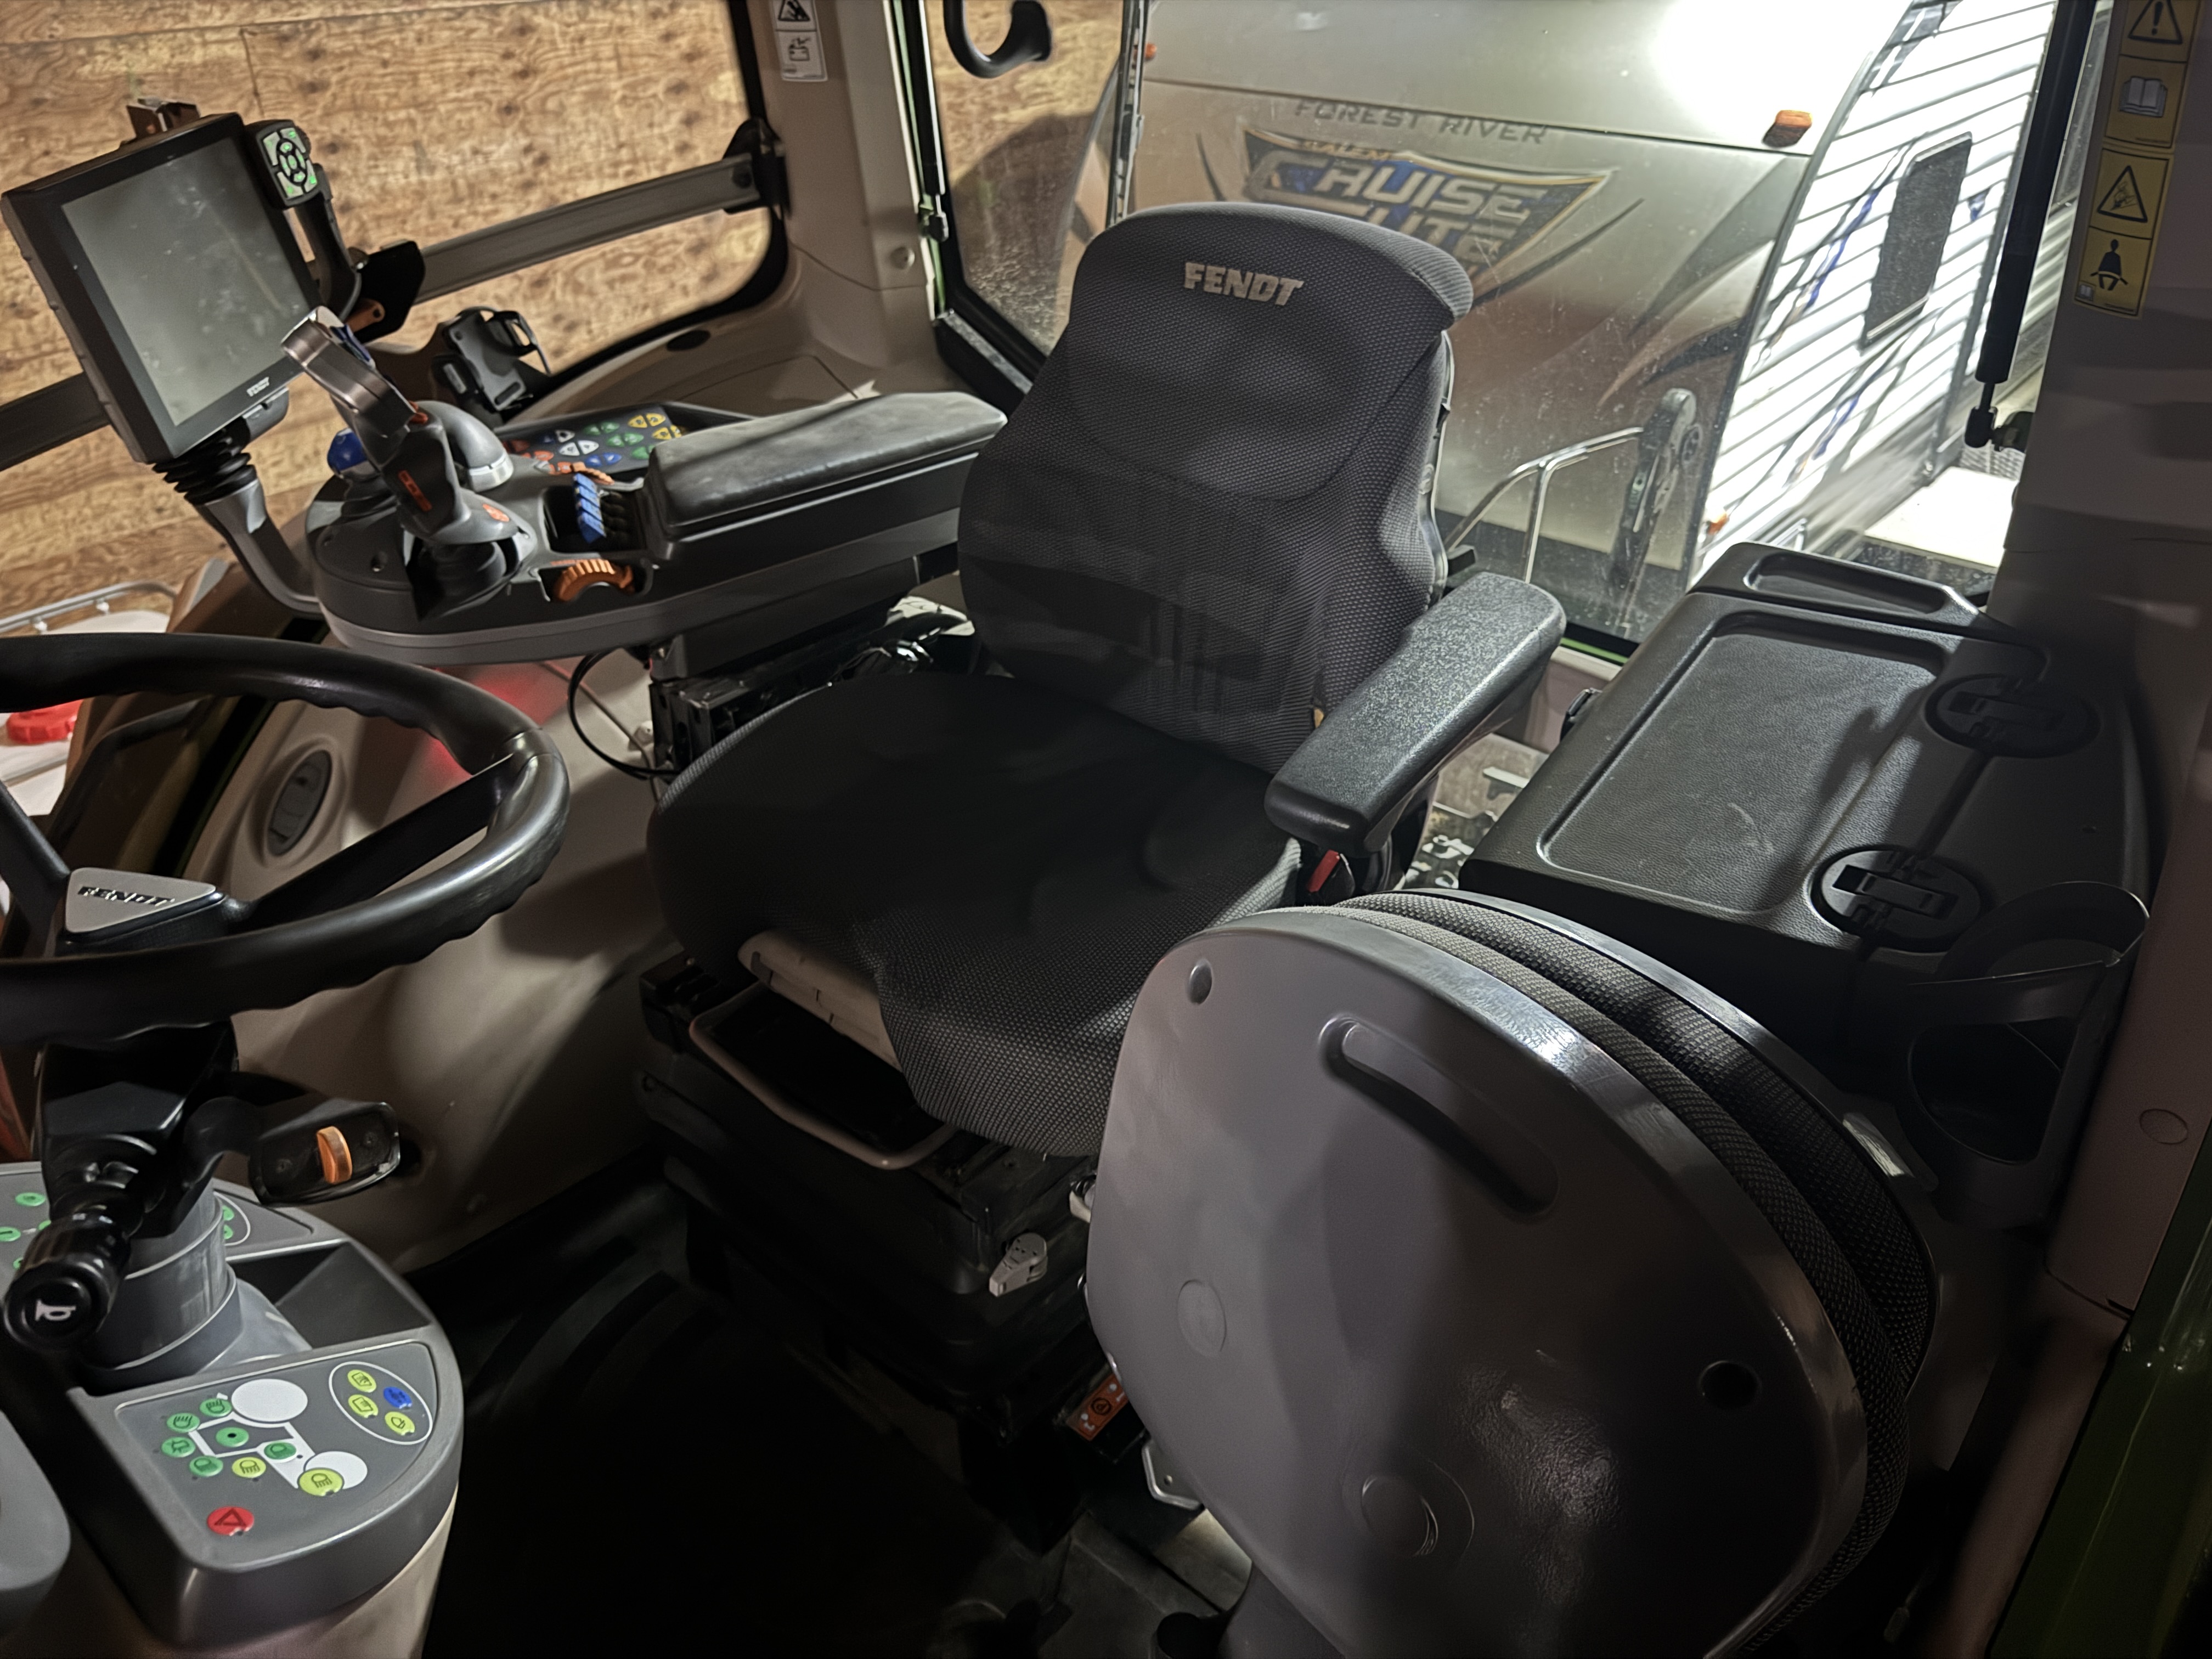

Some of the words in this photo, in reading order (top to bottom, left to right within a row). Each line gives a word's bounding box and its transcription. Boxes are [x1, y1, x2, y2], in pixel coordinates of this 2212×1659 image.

[1295, 100, 1420, 129] FOREST
[1438, 116, 1547, 144] RIVER
[1184, 262, 1305, 306] FENDT
